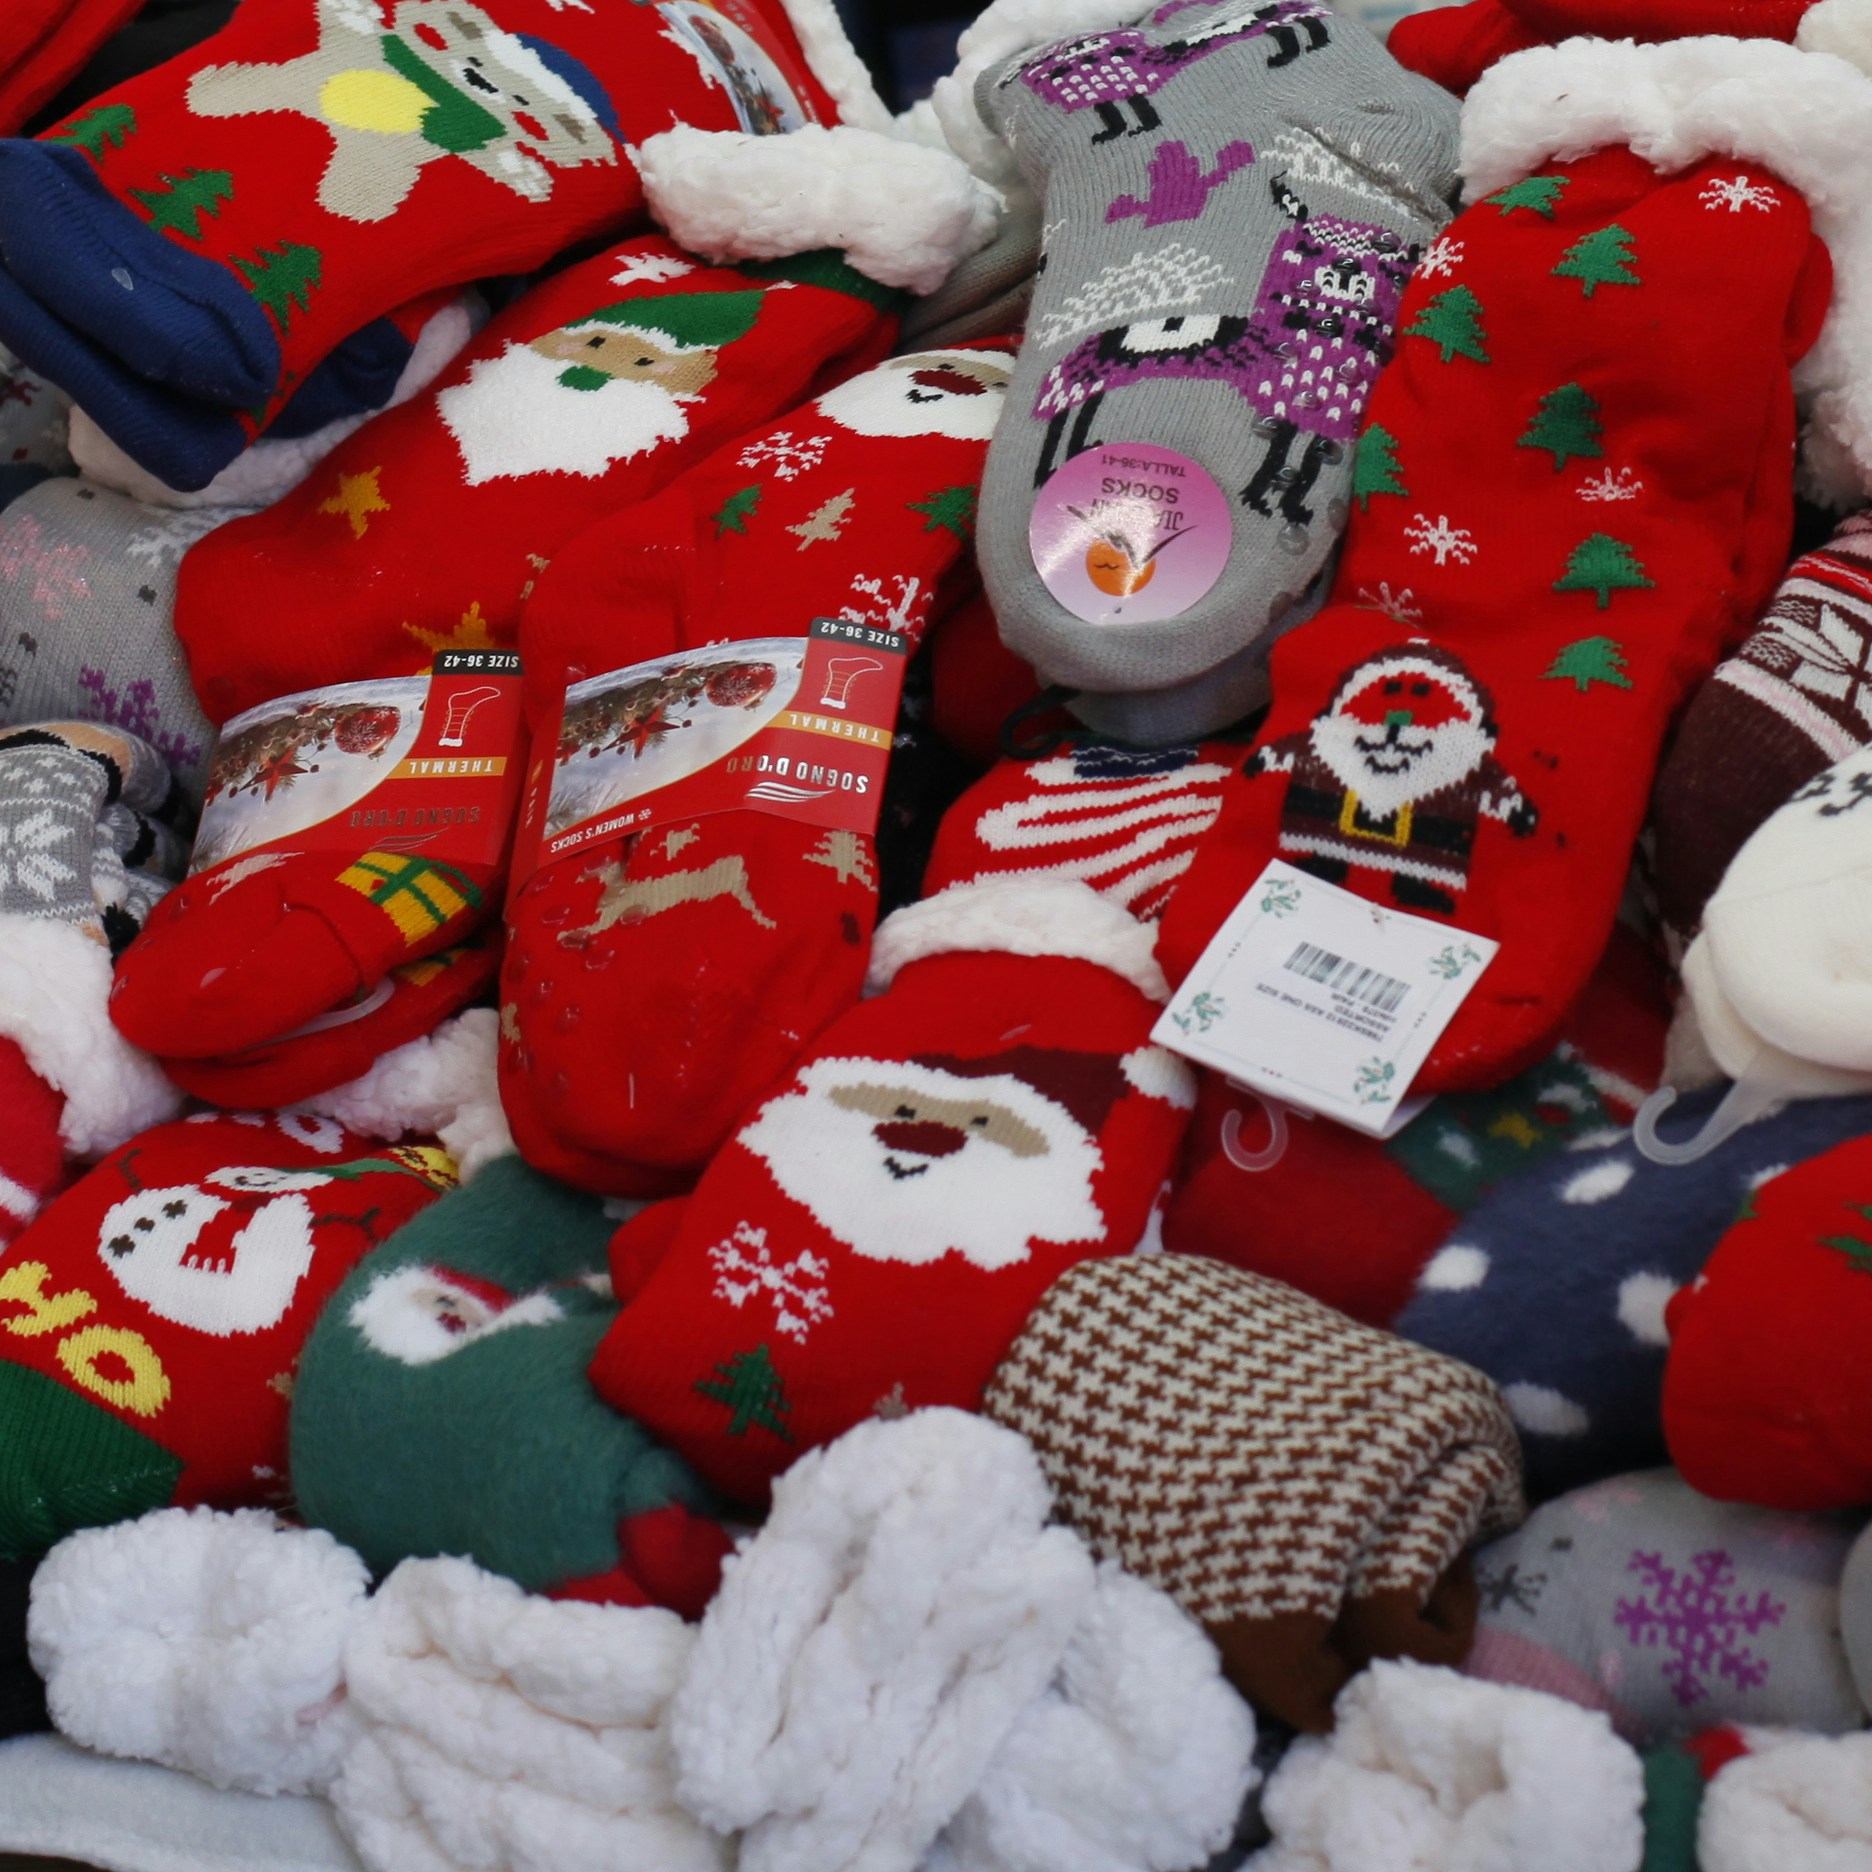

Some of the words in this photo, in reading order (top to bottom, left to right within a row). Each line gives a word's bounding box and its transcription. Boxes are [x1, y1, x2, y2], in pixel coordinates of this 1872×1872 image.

[1101, 454, 1186, 477] TALLA:36-41
[1101, 477, 1180, 504] SOCKS
[820, 620, 865, 639] 36-42
[867, 631, 900, 648] SIZE
[444, 655, 483, 668] 36-42
[487, 655, 520, 667] SIZE
[789, 713, 881, 743] THERMAL
[410, 760, 493, 773] THERMAL
[795, 761, 870, 793] SOGNO
[414, 807, 481, 825] SOGNO
[585, 813, 636, 838] WOMEN'S
[550, 830, 584, 854] SOCKS
